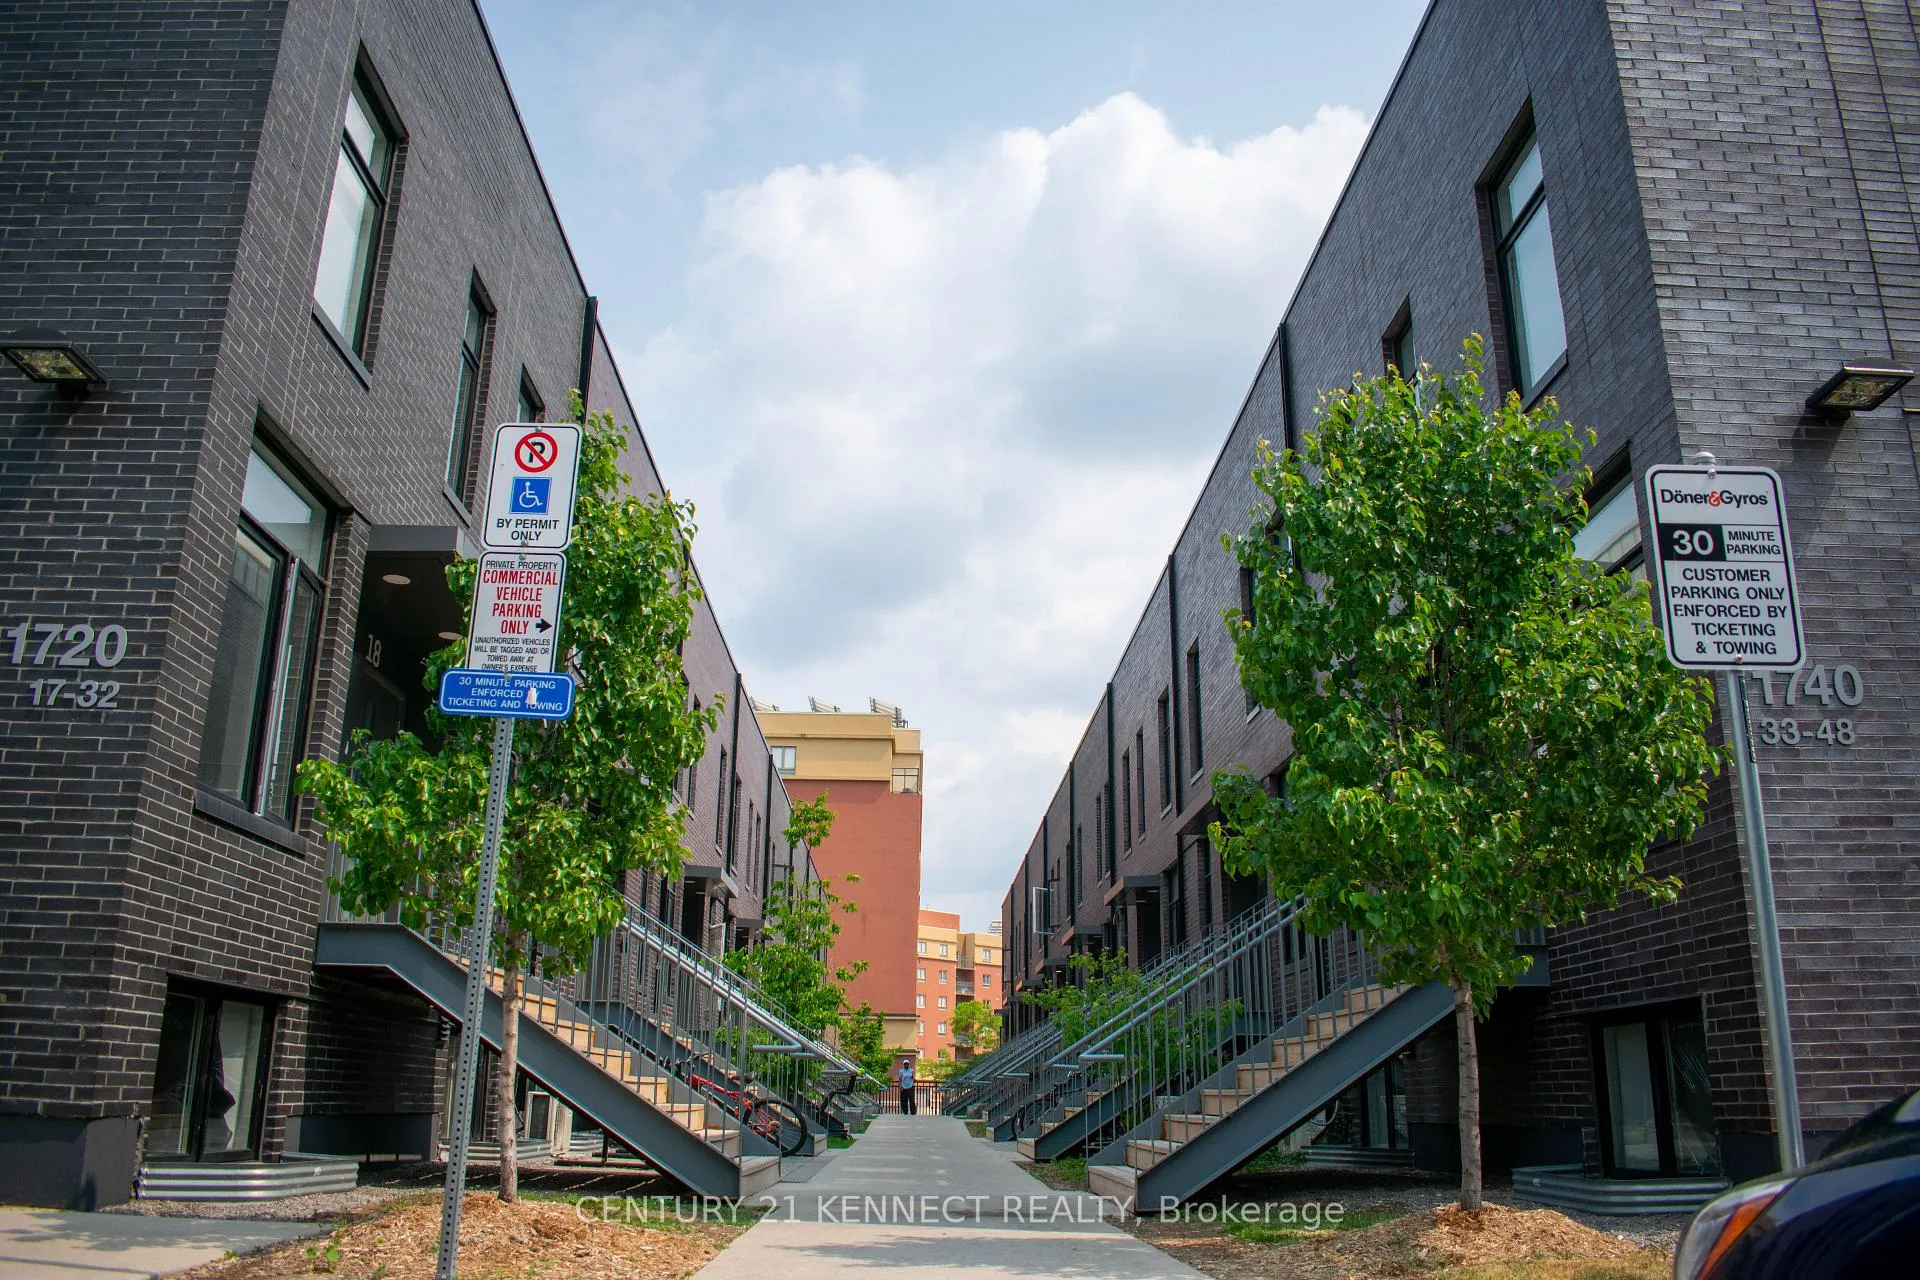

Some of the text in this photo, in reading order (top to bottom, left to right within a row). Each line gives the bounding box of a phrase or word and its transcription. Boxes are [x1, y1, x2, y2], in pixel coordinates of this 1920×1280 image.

[496, 518, 560, 529] BY PERMIT
[511, 530, 542, 541] ONLY
[1672, 529, 1714, 555] 30
[1728, 531, 1775, 542] MINUTE
[1726, 543, 1781, 555] PARKING
[486, 560, 559, 570] PRIVATE PROPERTY
[483, 569, 558, 586] COMMERCIAL
[1682, 567, 1771, 582] CUSTOMER
[496, 586, 543, 601] VEHICLE
[1671, 586, 1785, 600] PARKING ONLY
[492, 603, 542, 618] PARKING
[1673, 604, 1788, 618] ENFORCED BY
[500, 620, 530, 635] ONLY
[1691, 622, 1776, 637] TICKETING
[6, 622, 128, 668] 1720
[474, 636, 551, 646] UNAUTHORIZED VEHICLES
[1695, 641, 1777, 655] & TOWING
[365, 633, 382, 669] 18
[474, 645, 488, 653] WILL
[490, 645, 498, 653] BE
[500, 646, 524, 654] TAGGED
[525, 647, 538, 655] AND
[487, 654, 535, 664] TOWED AWAY AT
[510, 664, 538, 673] EXPENSE
[458, 677, 556, 689] 30 MINUTE PARKING
[1751, 664, 1864, 706] 1740
[29, 678, 121, 708] 17-32
[471, 687, 524, 698] ENFORCED
[447, 697, 497, 708] TICKETING
[500, 700, 521, 709] AND
[1760, 717, 1856, 745] 33-48
